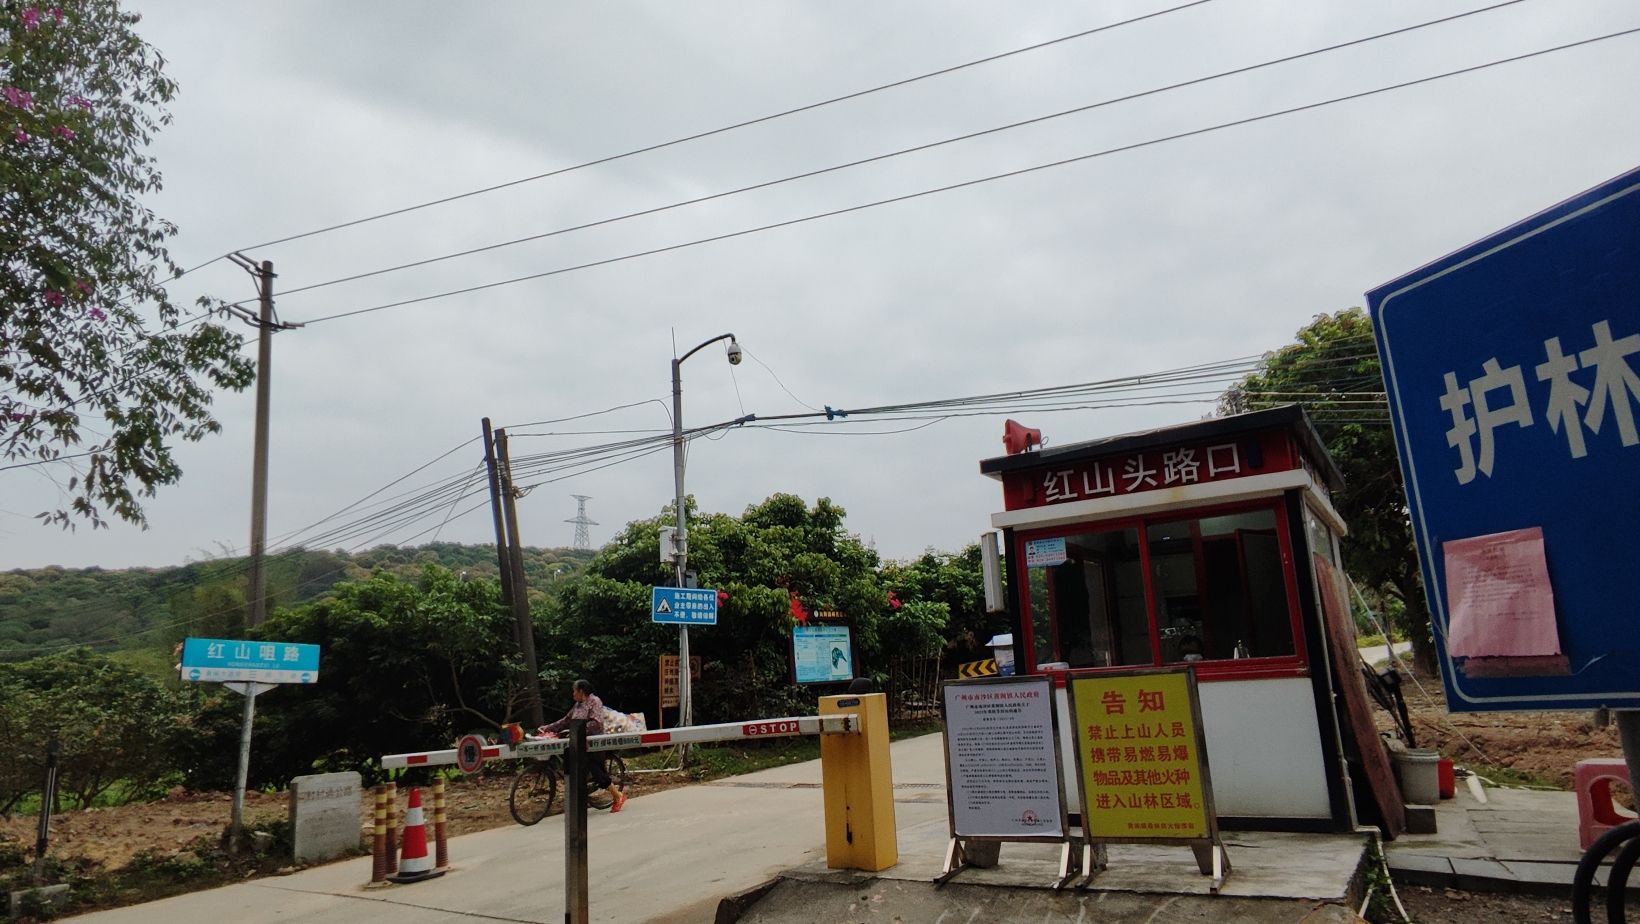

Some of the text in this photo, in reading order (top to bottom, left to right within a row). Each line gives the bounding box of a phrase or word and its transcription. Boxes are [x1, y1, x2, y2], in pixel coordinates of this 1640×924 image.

[1439, 319, 1640, 486] 护林
[1043, 443, 1241, 503] 红山头路口
[1101, 689, 1165, 715] 告知
[760, 722, 798, 734] STOP
[1088, 722, 1186, 741] 禁止上山人员
[1090, 745, 1189, 764] 携带易燃易爆
[1093, 768, 1190, 786] 物品及其他火种
[1096, 793, 1200, 809] 进入山林区域。
